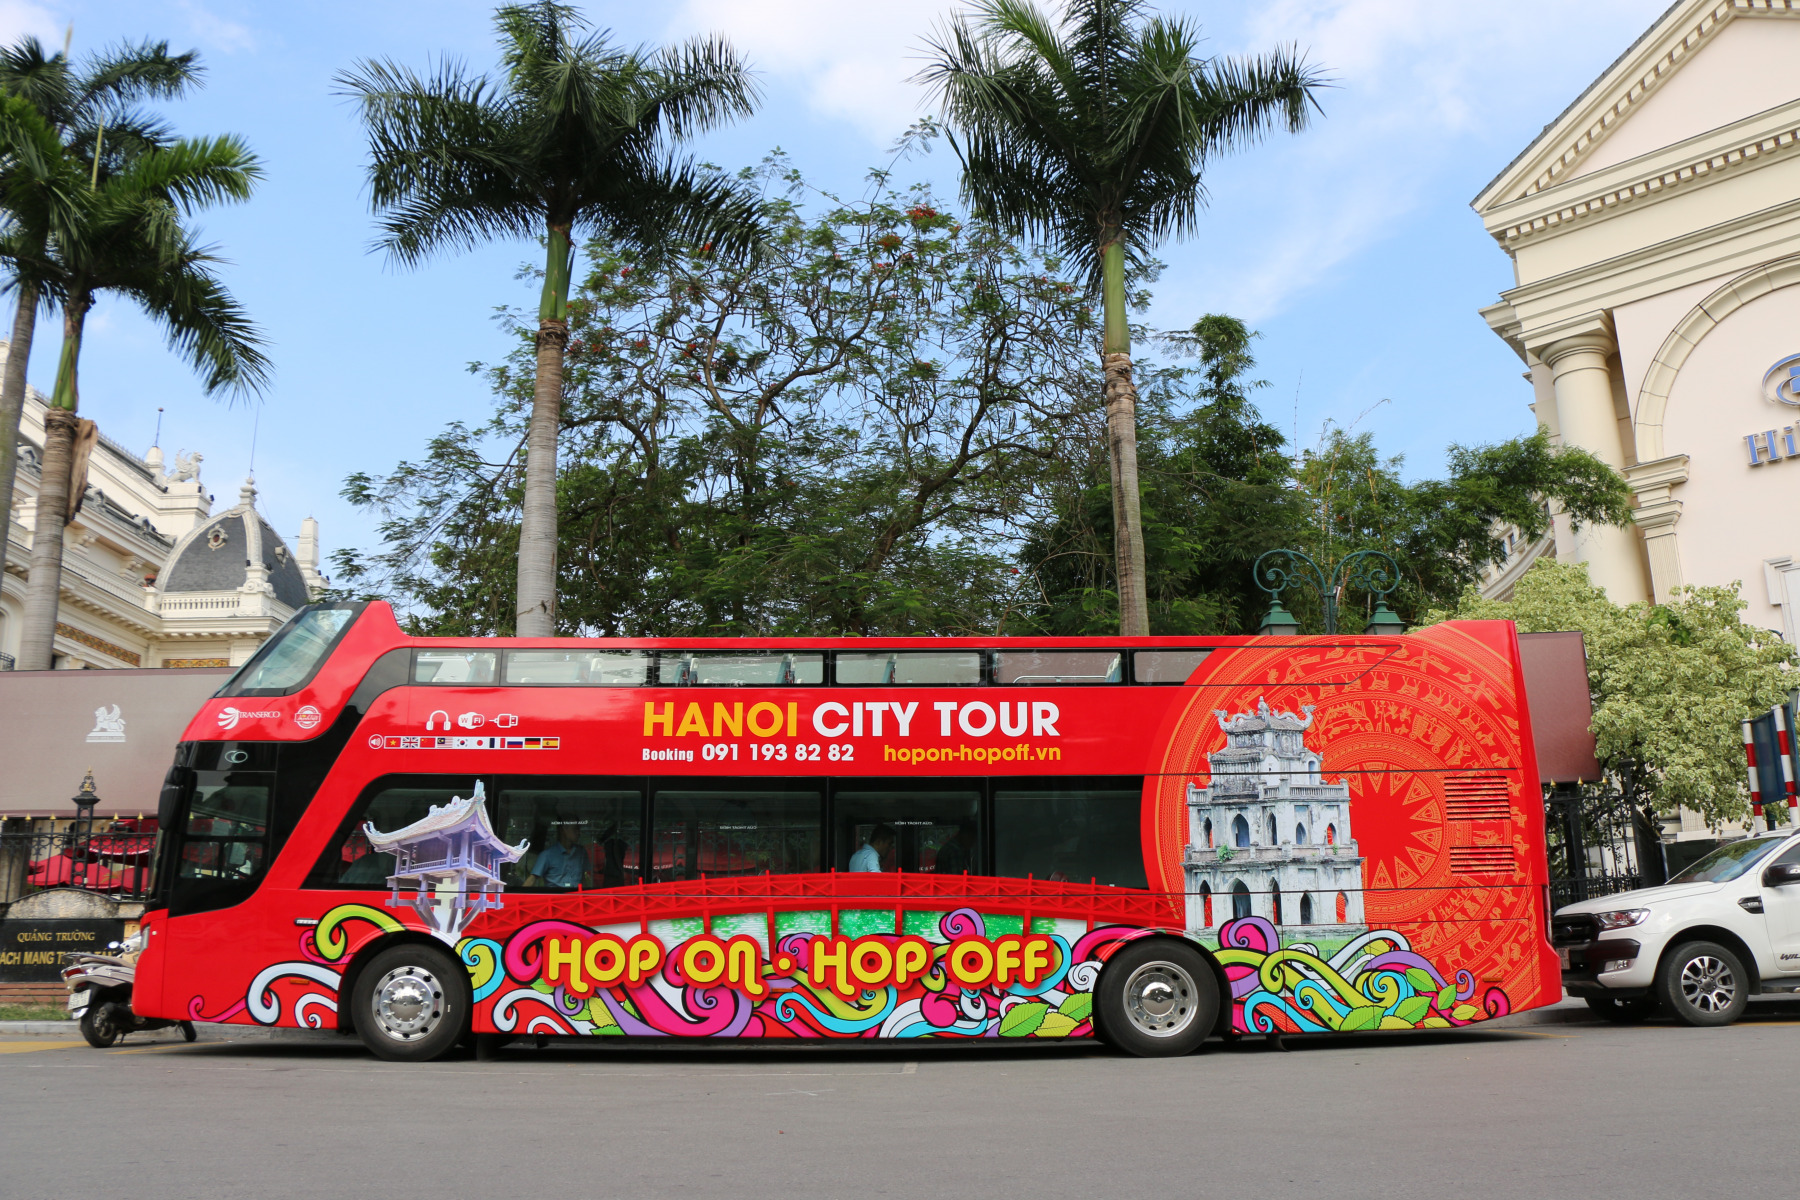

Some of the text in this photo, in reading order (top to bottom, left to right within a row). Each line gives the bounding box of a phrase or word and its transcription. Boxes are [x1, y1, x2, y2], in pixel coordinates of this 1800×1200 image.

[1743, 419, 1800, 466] Hi
[239, 710, 281, 719] TRANSERCO
[643, 701, 1061, 738] HANOI CITY TOUR
[642, 743, 854, 762] Booking 091 193 82 82
[884, 743, 1062, 765] hopon-hopoff.vn
[0, 948, 21, 965] ÁCH
[23, 951, 55, 966] MẠNG
[548, 938, 661, 993] HOP
[813, 940, 928, 996] HOP
[951, 940, 1048, 984] OFF
